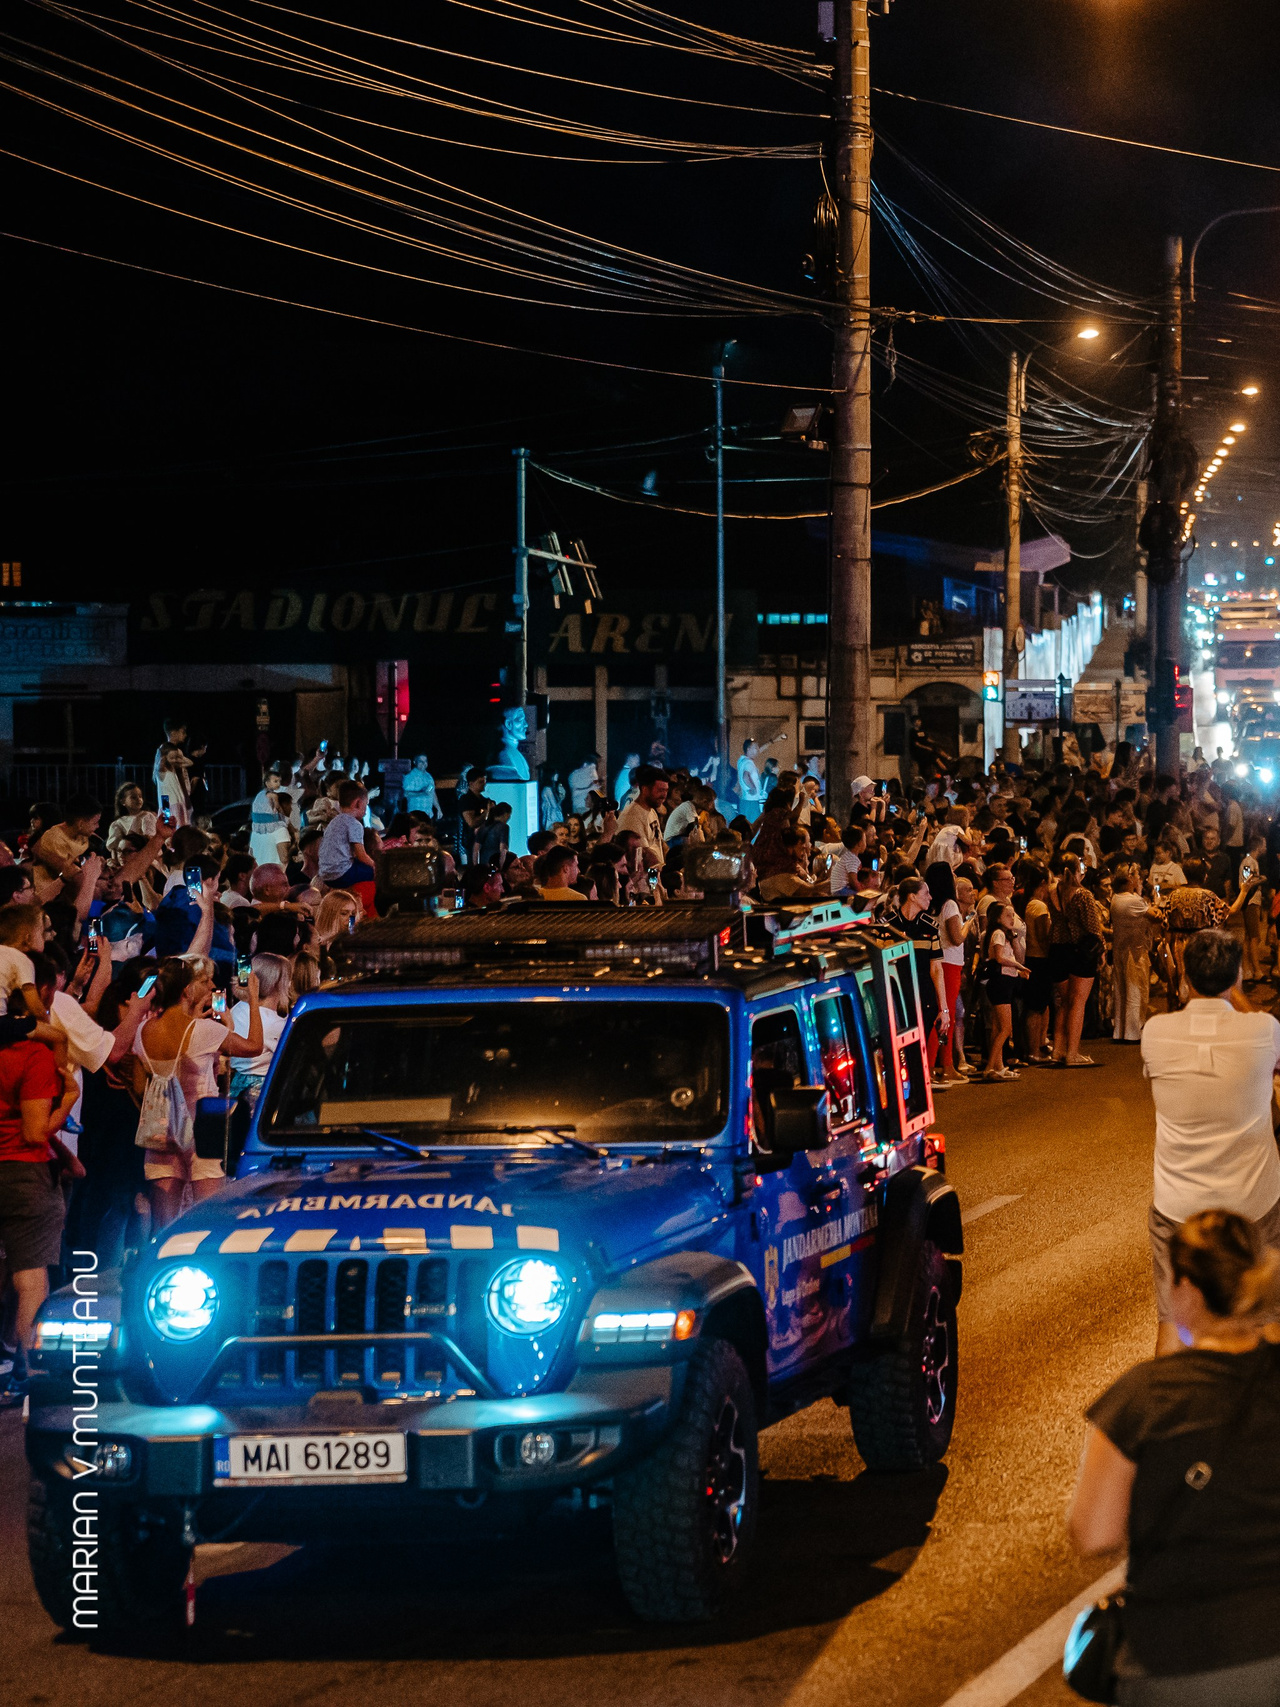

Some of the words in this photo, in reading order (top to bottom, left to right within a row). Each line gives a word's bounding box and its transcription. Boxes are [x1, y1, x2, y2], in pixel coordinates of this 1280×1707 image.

[140, 589, 498, 633] STADIONUL
[243, 1443, 290, 1472] MAI
[304, 1439, 391, 1471] 61289
